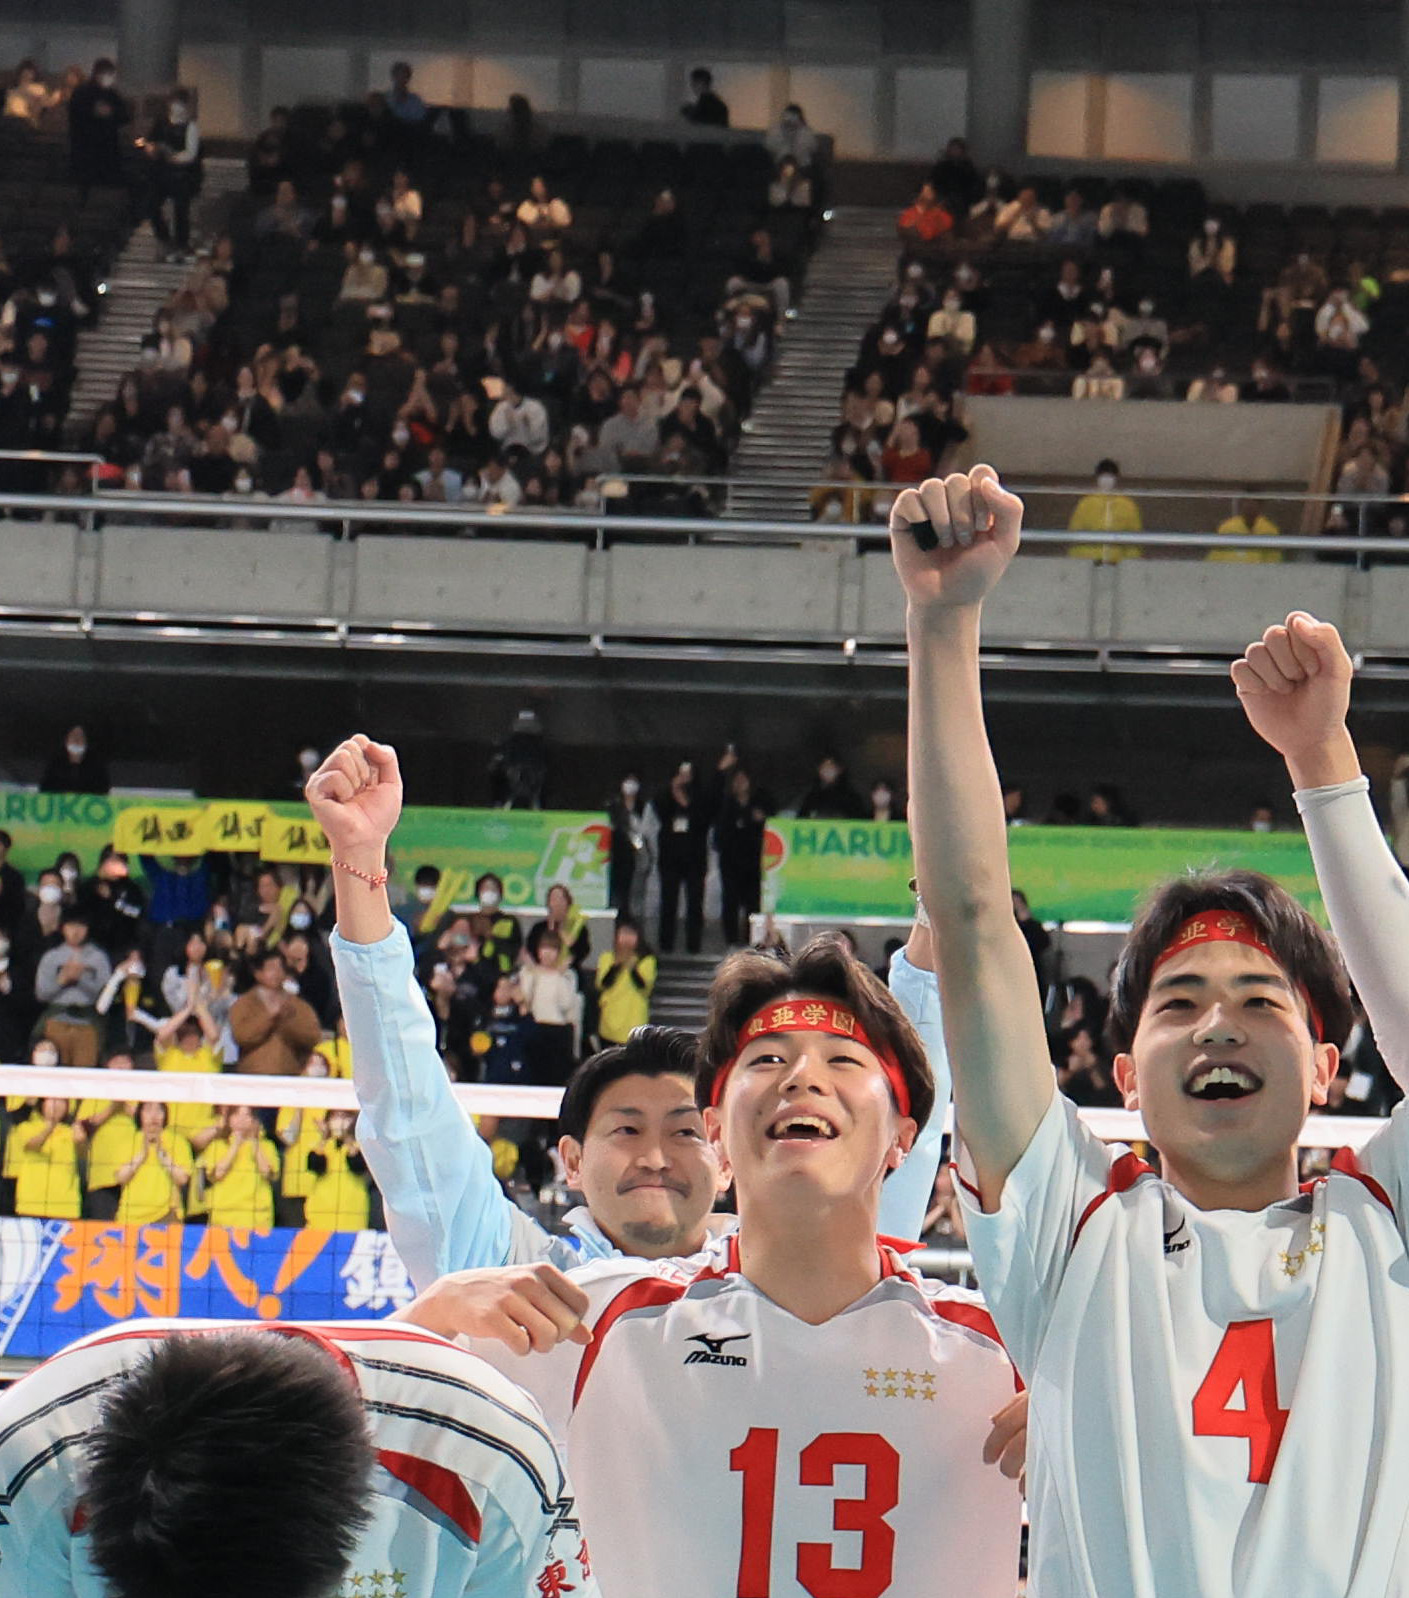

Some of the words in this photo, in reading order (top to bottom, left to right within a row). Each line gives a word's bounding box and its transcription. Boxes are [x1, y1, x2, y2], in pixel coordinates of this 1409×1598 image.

[0, 792, 113, 827] RUKO
[683, 1350, 748, 1368] MIZUNO
[1191, 1317, 1291, 1486] 4
